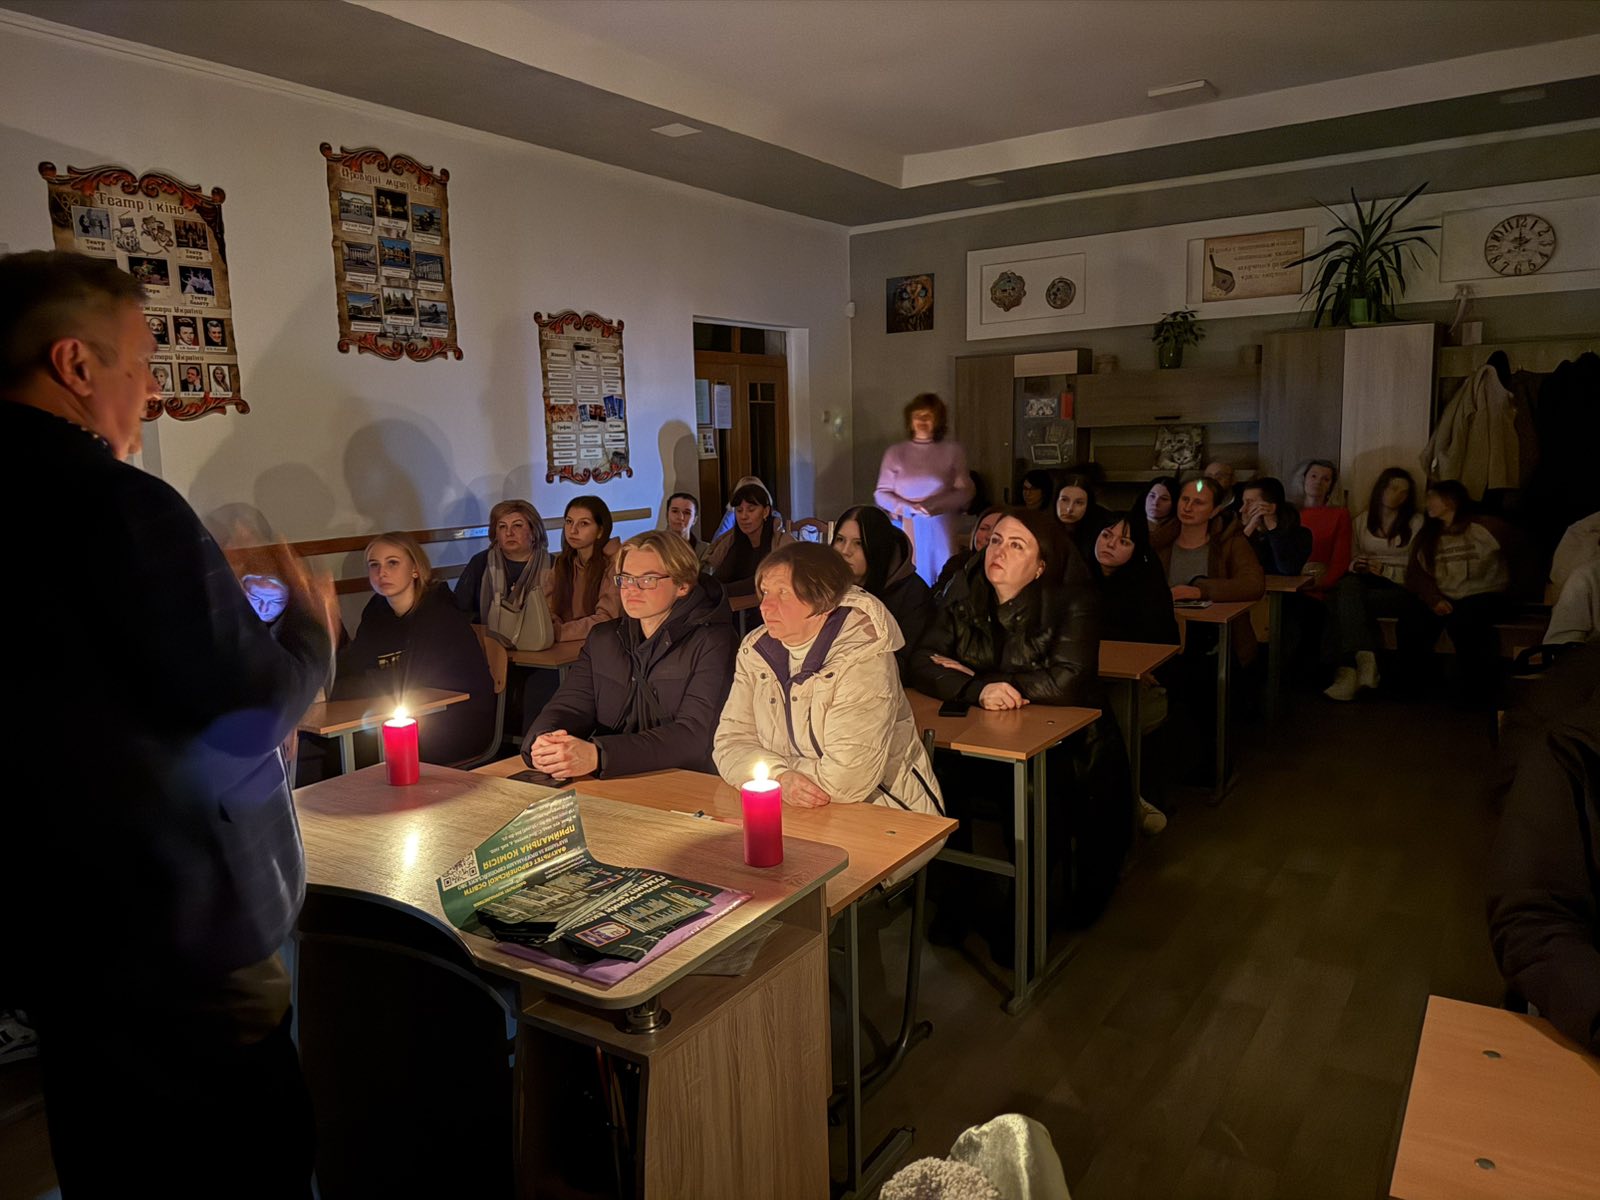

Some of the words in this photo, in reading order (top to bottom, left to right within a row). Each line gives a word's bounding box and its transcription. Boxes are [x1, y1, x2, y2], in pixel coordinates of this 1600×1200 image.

[341, 168, 381, 184] Провідні
[386, 178, 409, 189] музеї
[96, 192, 144, 212] Театр
[148, 200, 153, 211] і
[156, 202, 185, 215] кіно
[1516, 217, 1527, 228] 12
[520, 824, 576, 854] ПРИЙМАЛЬНА
[482, 848, 519, 870] КОМІСІЯ
[533, 846, 567, 865] ФАКУЛЬТЕТ
[487, 860, 533, 886] ЄВРОПЕЙСЬКОЇ
[463, 880, 487, 896] ОСВІТИ
